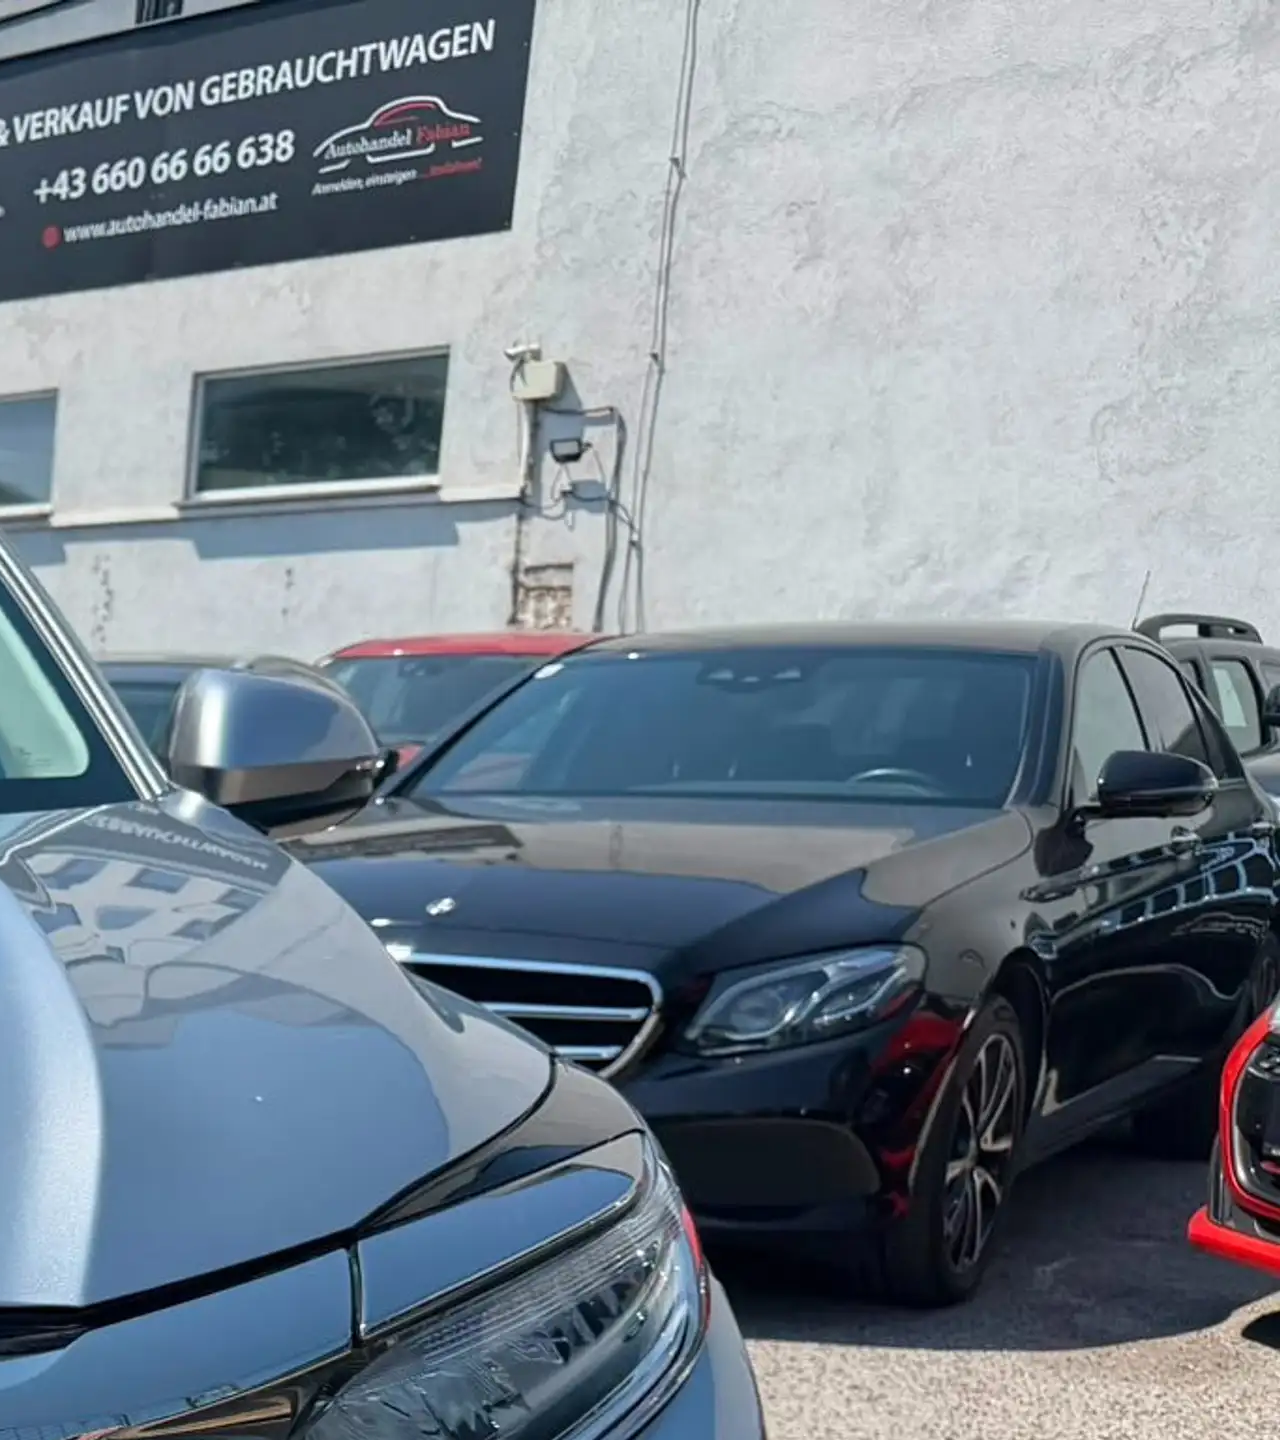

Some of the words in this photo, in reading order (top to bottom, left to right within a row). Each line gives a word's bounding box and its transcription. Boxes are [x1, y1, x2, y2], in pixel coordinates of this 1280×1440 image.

[13, 94, 130, 146] VERKAUF
[135, 80, 195, 118] VON
[200, 18, 497, 107] GEBRAUCHTWAGEN
[33, 166, 87, 204] +43
[91, 157, 146, 195] 660
[150, 148, 189, 185] 66
[193, 140, 232, 177] 66
[236, 129, 296, 169] 638
[323, 128, 413, 160] Autohandel
[416, 123, 472, 146] Fabian
[62, 191, 279, 243] www.autohandel-fabian.at
